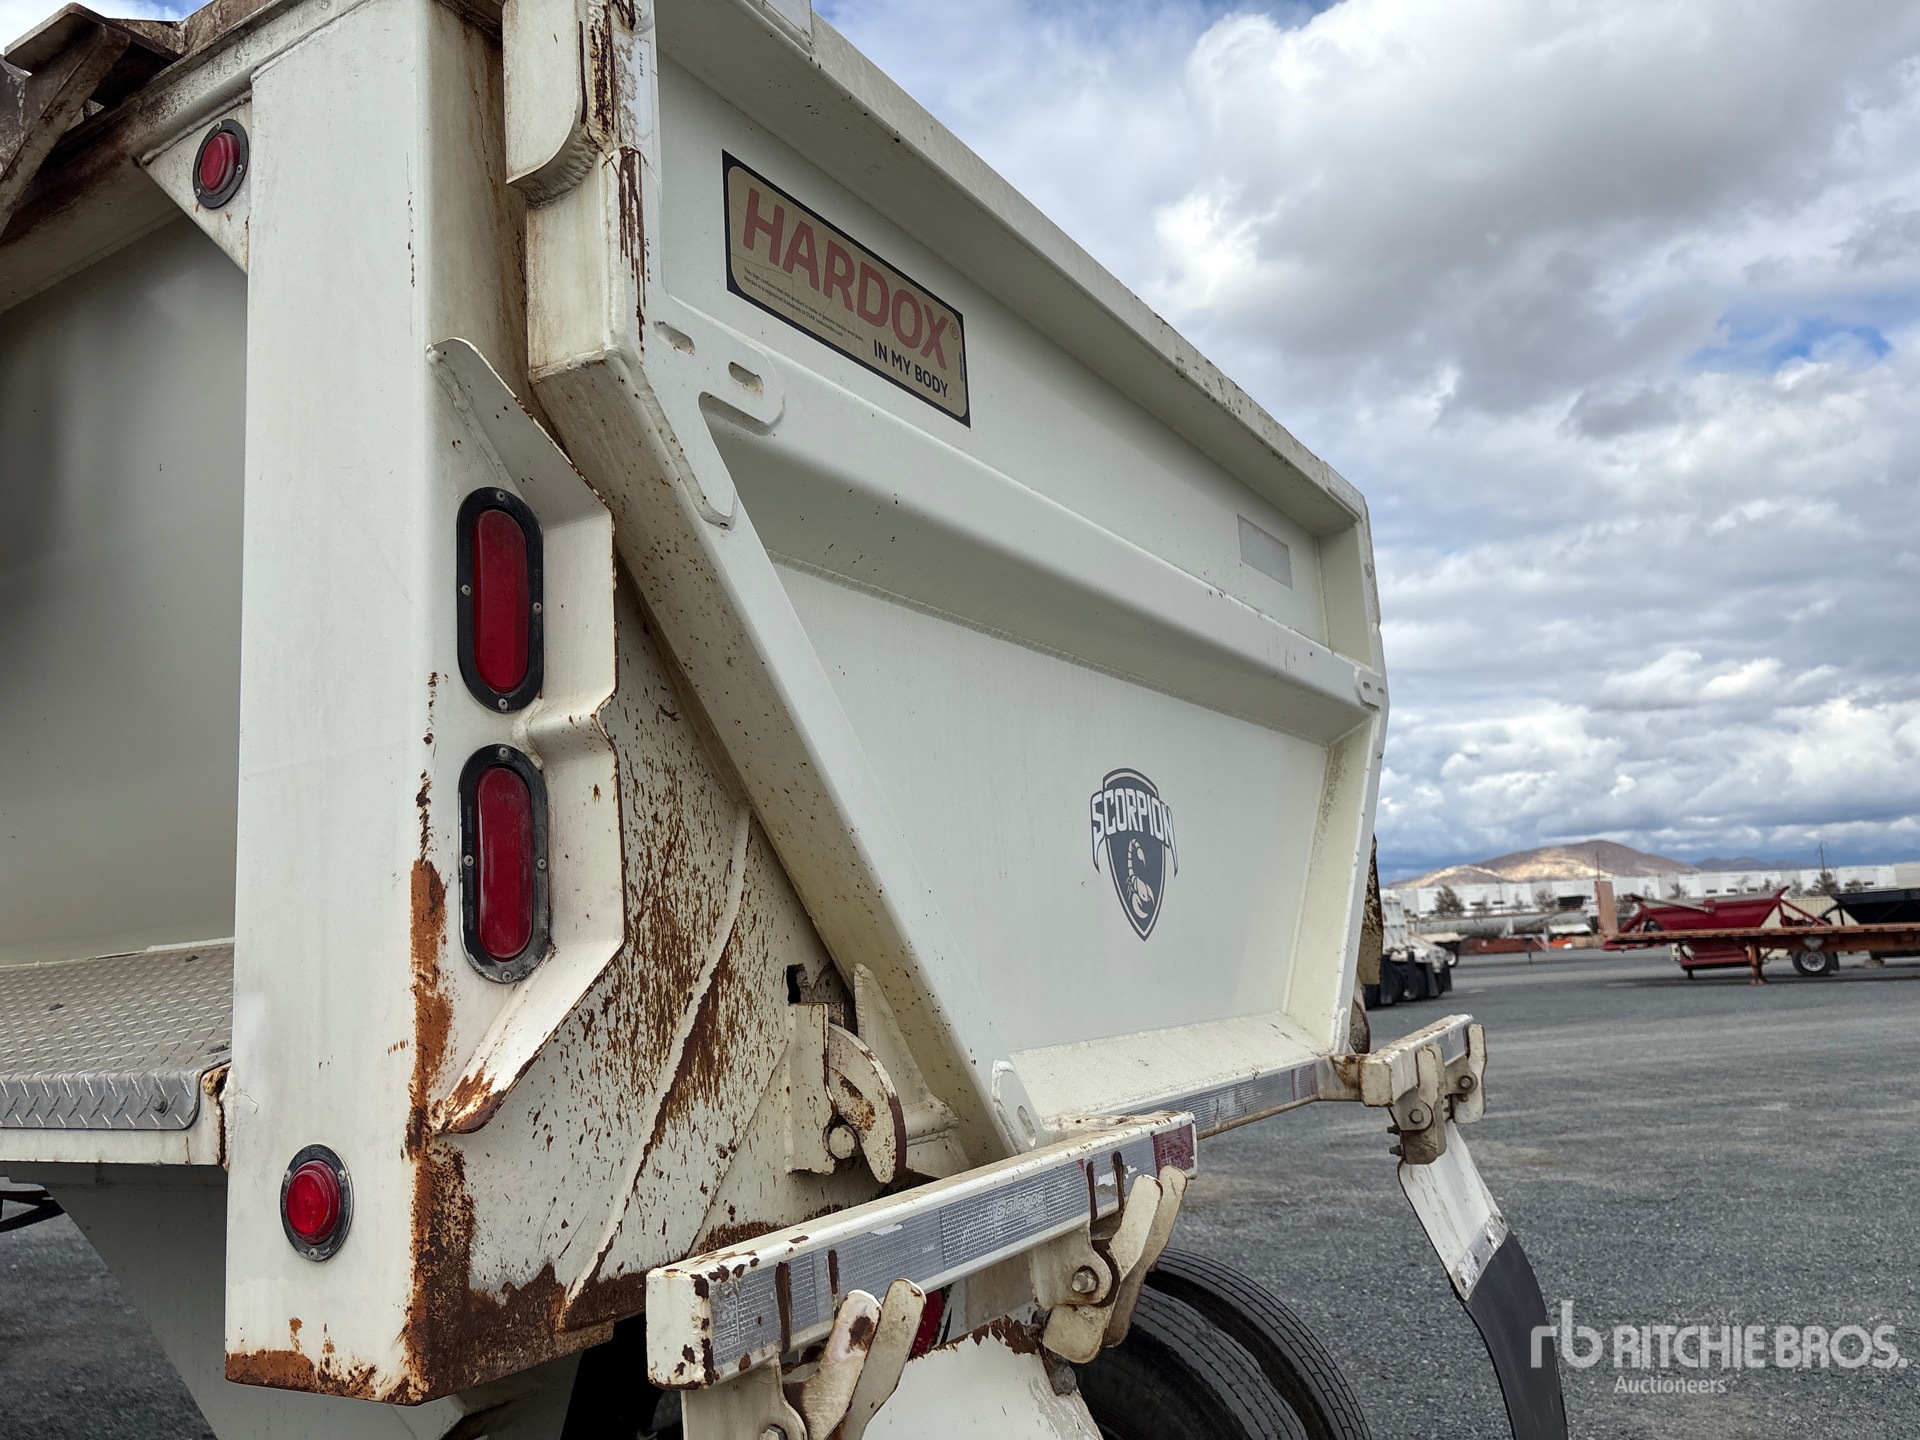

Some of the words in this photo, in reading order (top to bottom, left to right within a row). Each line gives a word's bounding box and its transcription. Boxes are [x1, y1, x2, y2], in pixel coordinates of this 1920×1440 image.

[873, 339, 888, 364] IN
[891, 349, 911, 376] MY
[914, 365, 949, 398] BODY
[1090, 788, 1178, 876] SCORPION
